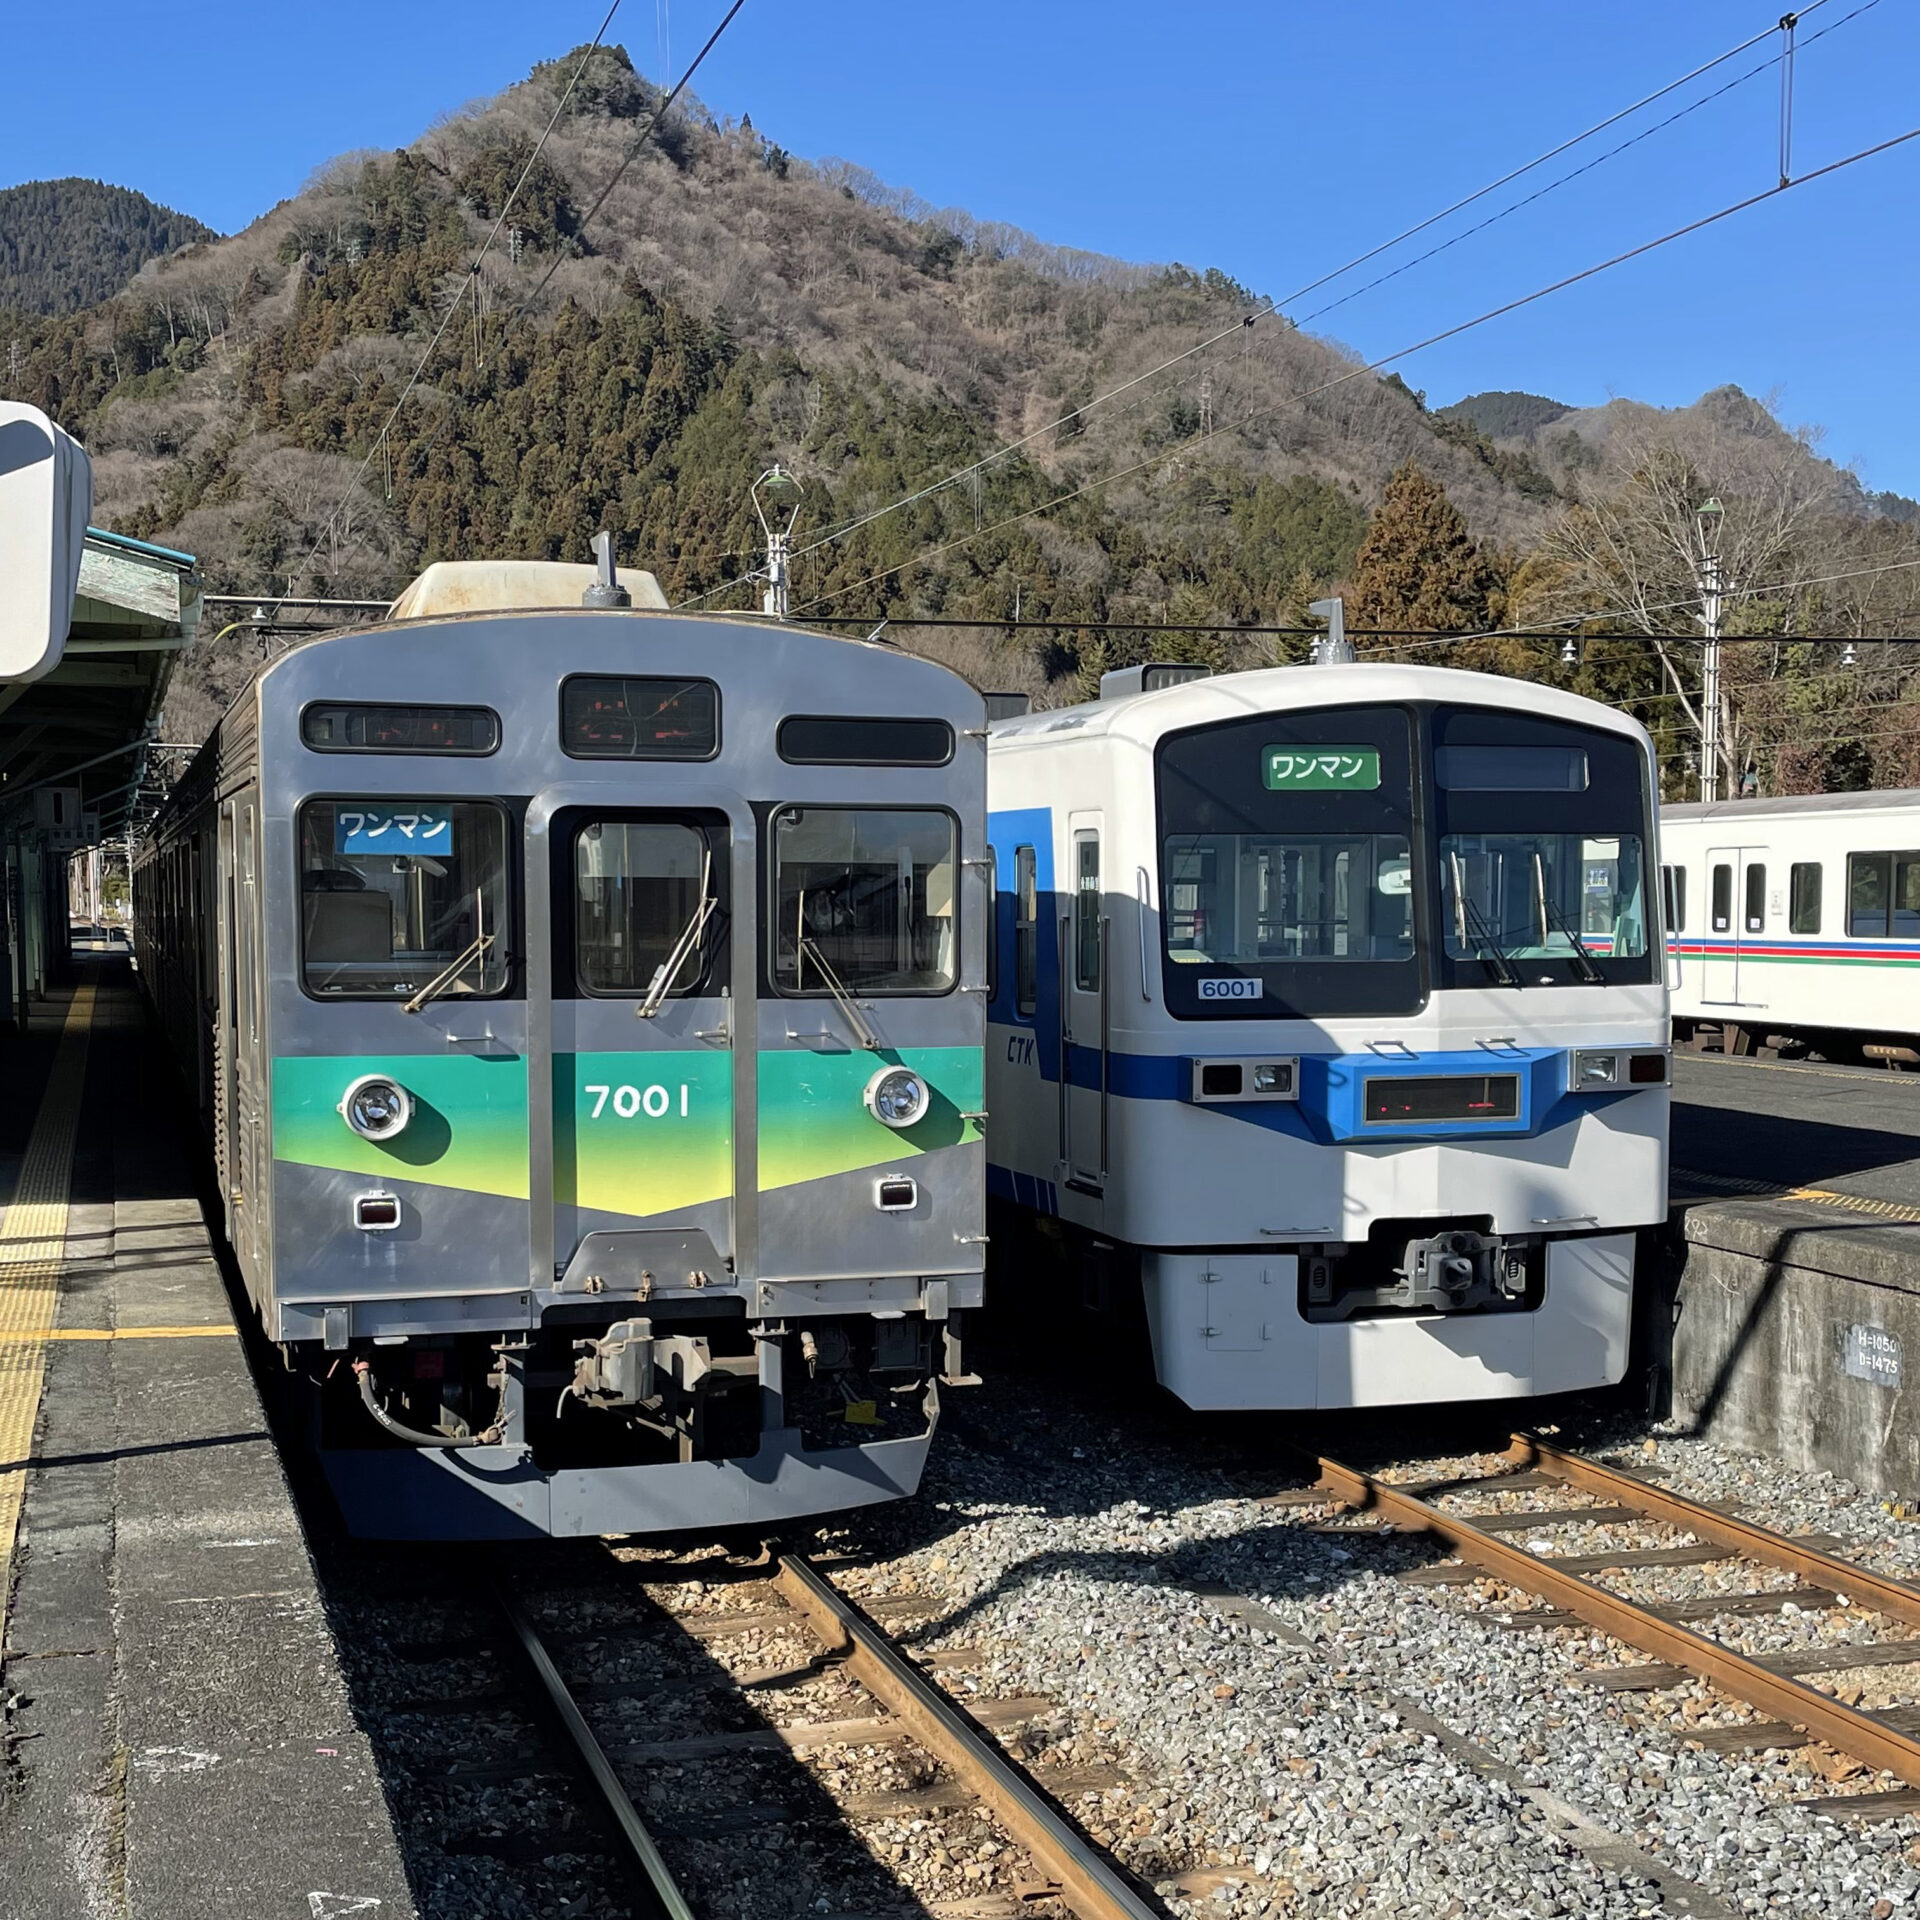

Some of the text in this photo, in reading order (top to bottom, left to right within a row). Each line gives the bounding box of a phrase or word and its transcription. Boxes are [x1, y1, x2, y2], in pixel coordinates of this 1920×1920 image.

[1272, 756, 1363, 779] ワンマン
[340, 813, 446, 838] ワンマン
[1202, 981, 1255, 997] 6001
[1007, 1036, 1034, 1066] CTK
[584, 1084, 688, 1118] 7001
[1859, 1330, 1896, 1353] H=1050
[1859, 1351, 1898, 1374] D=1475
